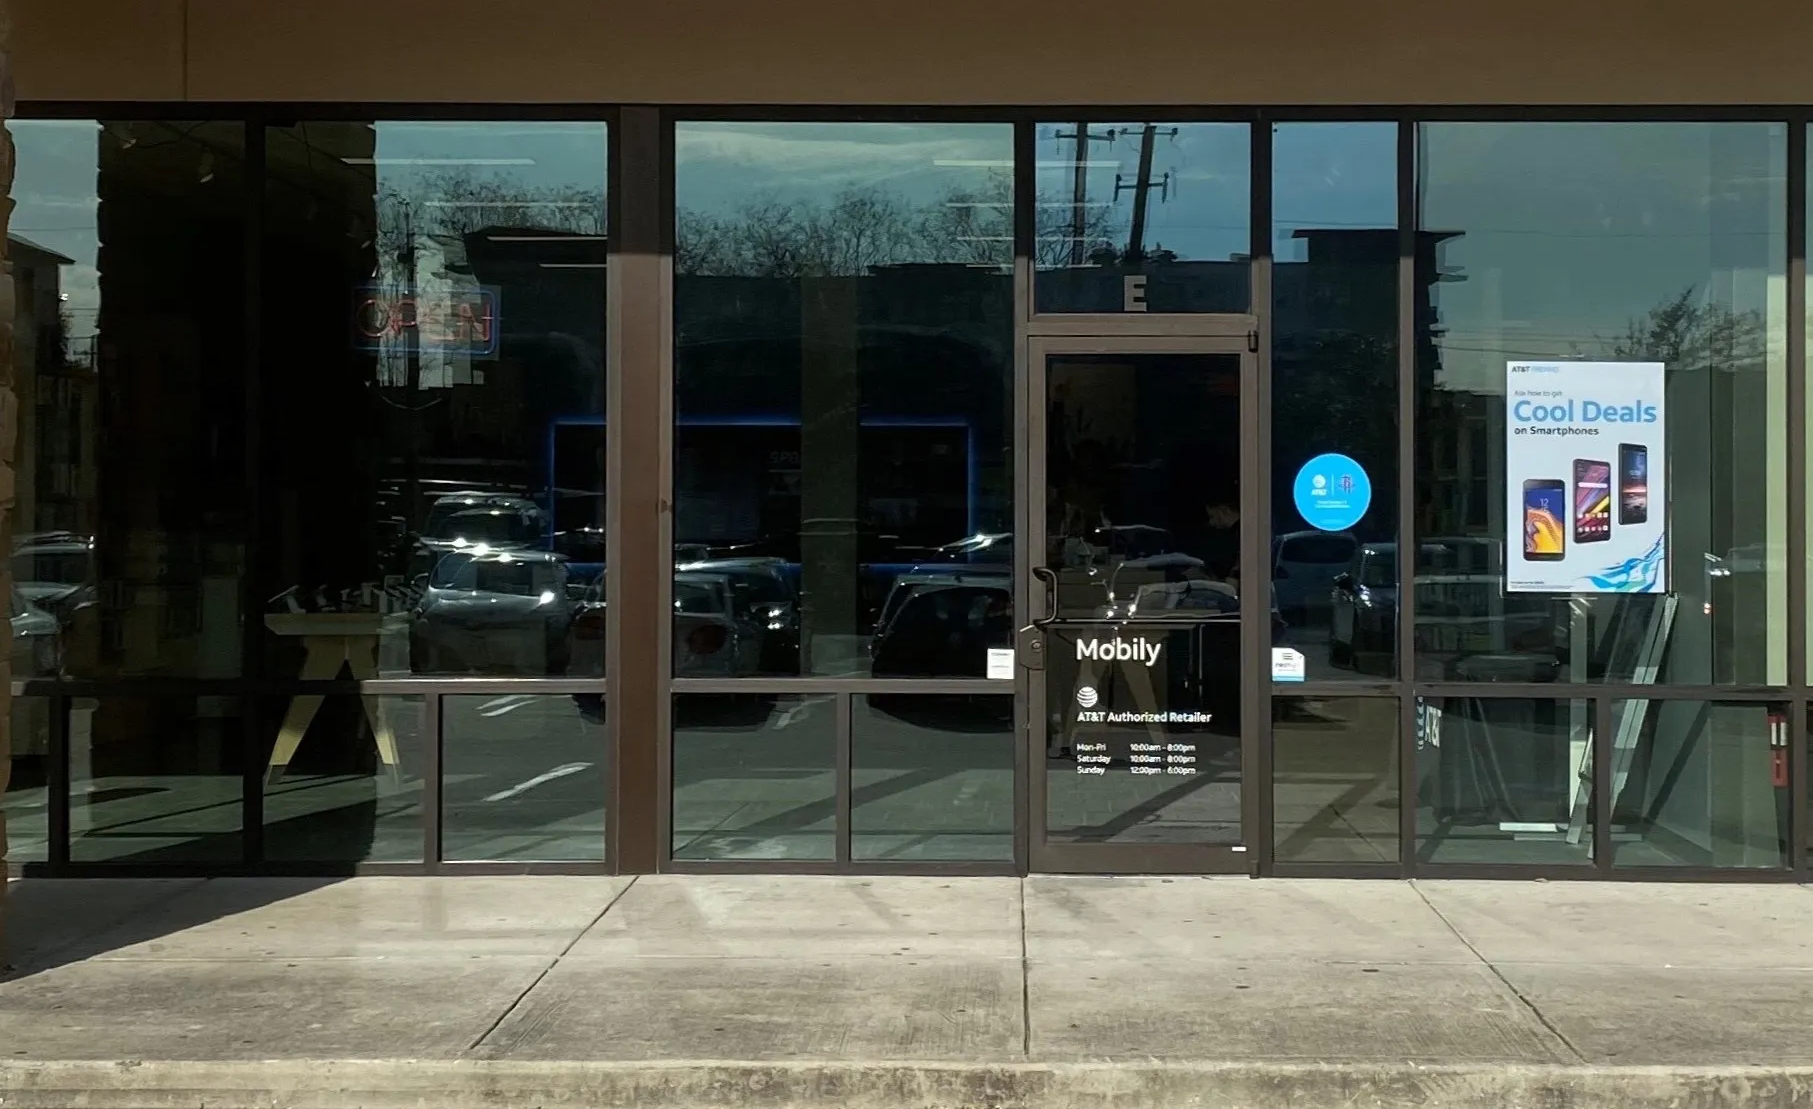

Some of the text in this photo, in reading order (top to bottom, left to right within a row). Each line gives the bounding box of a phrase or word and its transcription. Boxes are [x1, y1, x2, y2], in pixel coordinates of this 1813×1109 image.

[1124, 275, 1147, 311] E
[1514, 399, 1657, 424] Cool Deals
[1514, 426, 1599, 436] on Smartphones
[1076, 637, 1161, 666] Mobily
[1077, 712, 1212, 722] AT&T Authorized Retailer
[1076, 743, 1107, 751] Mon-Fri
[1130, 743, 1161, 751] 10:00am
[1167, 743, 1196, 753] 8:00pm
[1077, 755, 1111, 764] Saturday
[1167, 755, 1196, 764] 8:00pm
[1077, 766, 1105, 775] Sunday
[1130, 767, 1161, 775] 12:00pm
[1167, 767, 1196, 775] 6:00pm
